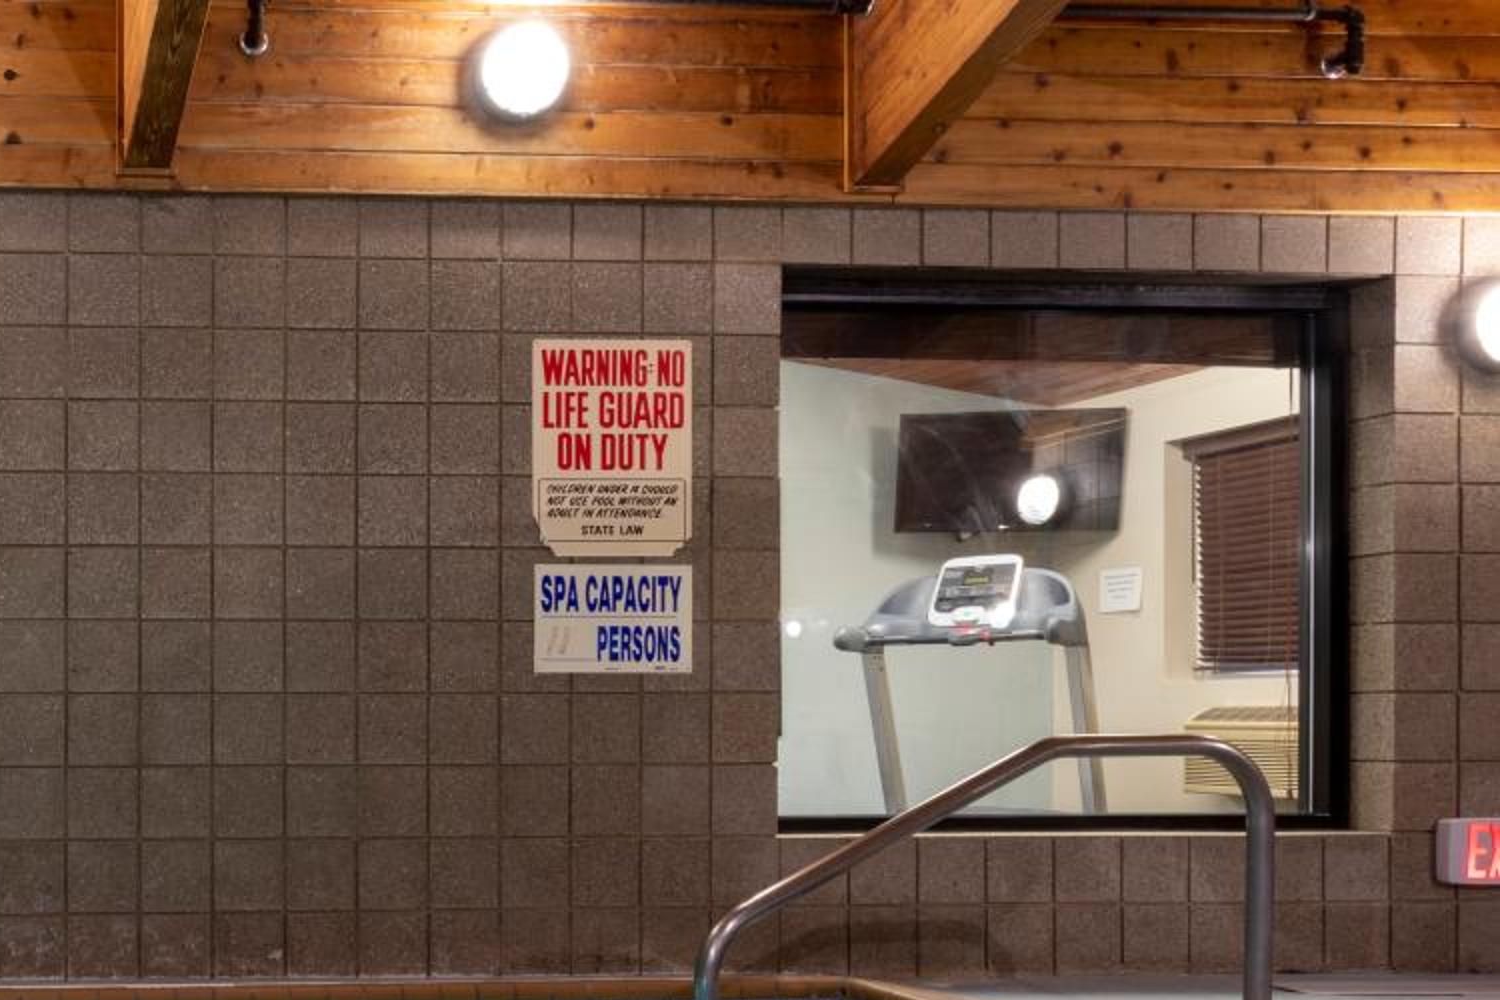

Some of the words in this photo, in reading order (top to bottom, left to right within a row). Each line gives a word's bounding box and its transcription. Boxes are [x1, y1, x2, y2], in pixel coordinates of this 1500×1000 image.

[657, 350, 685, 387] NO
[543, 391, 589, 429] LIFE
[599, 391, 684, 429] GUARD
[557, 432, 592, 471] ON
[601, 433, 668, 471] DUTY
[547, 484, 596, 494] CHILDREN
[597, 484, 628, 494] UNDER
[547, 496, 567, 506] NOT
[569, 496, 589, 506] USE
[591, 496, 616, 506] POOL
[618, 496, 663, 506] WITHOUT
[664, 497, 677, 505] AN
[547, 508, 580, 518] ADULT
[582, 508, 595, 518] IN
[596, 508, 662, 519] ATTENDANCE
[581, 525, 614, 535] STATE
[619, 525, 644, 535] LAW
[541, 574, 579, 613] SPA
[585, 575, 682, 612] CAPACITY
[597, 626, 681, 662] PERSONS
